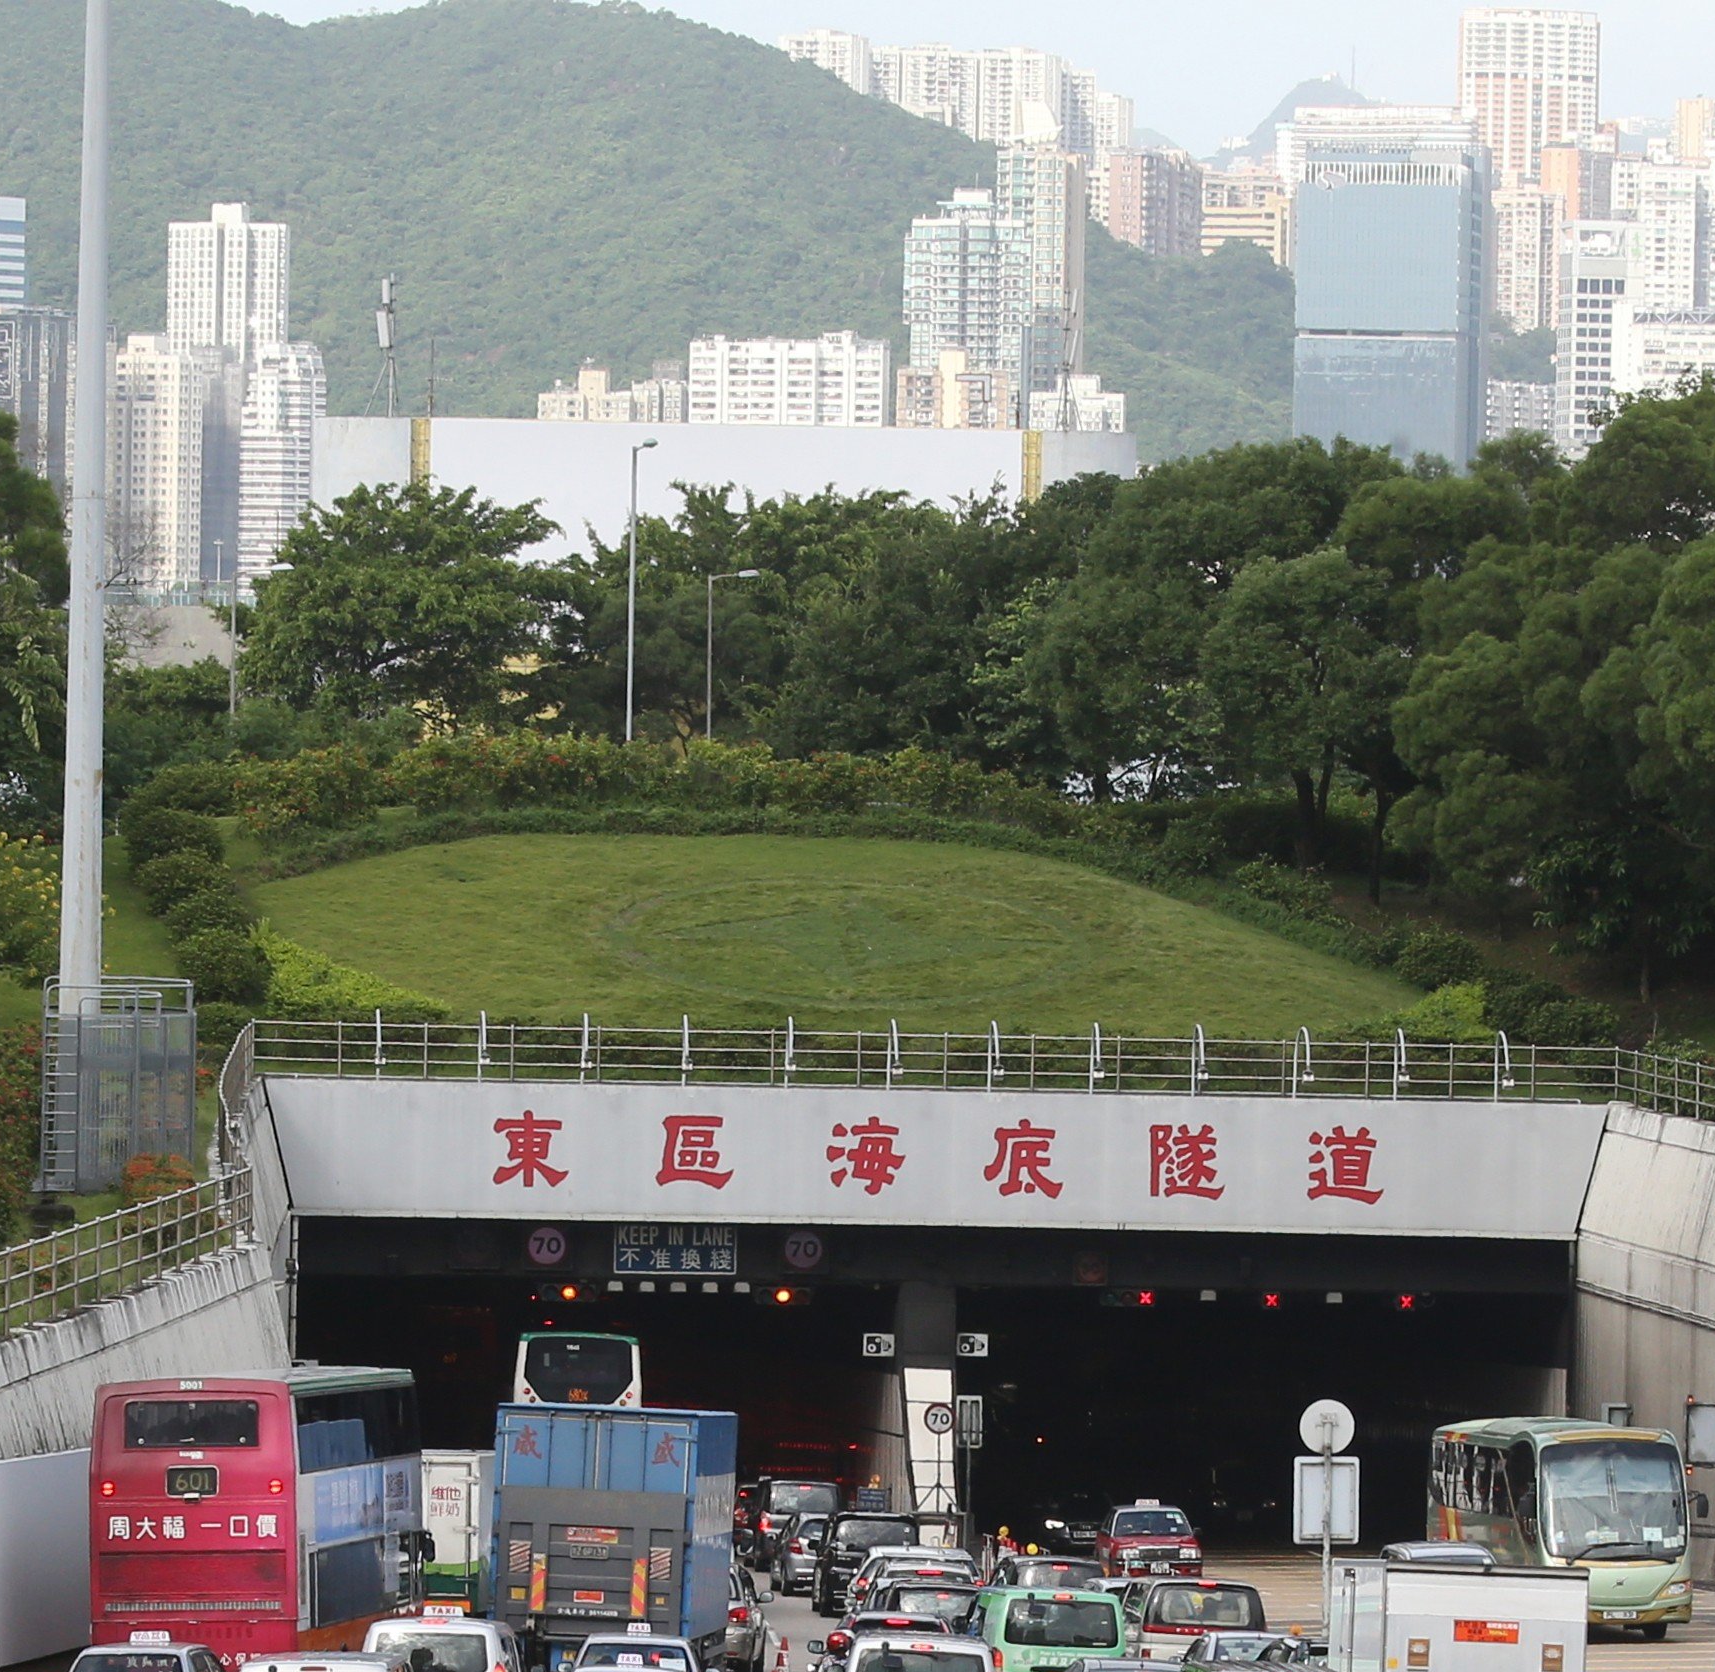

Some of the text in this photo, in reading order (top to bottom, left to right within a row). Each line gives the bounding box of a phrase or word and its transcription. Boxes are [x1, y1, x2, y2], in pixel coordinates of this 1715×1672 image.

[491, 1112, 1386, 1205] 東區海底隧道
[532, 1234, 563, 1257] 70
[617, 1225, 735, 1247] KEEP IN LANE
[785, 1239, 815, 1260] 70
[929, 1412, 950, 1424] 70
[175, 1472, 212, 1492] 601
[107, 1513, 278, 1541] 周大福 一口價
[617, 1654, 643, 1665] TAXI
